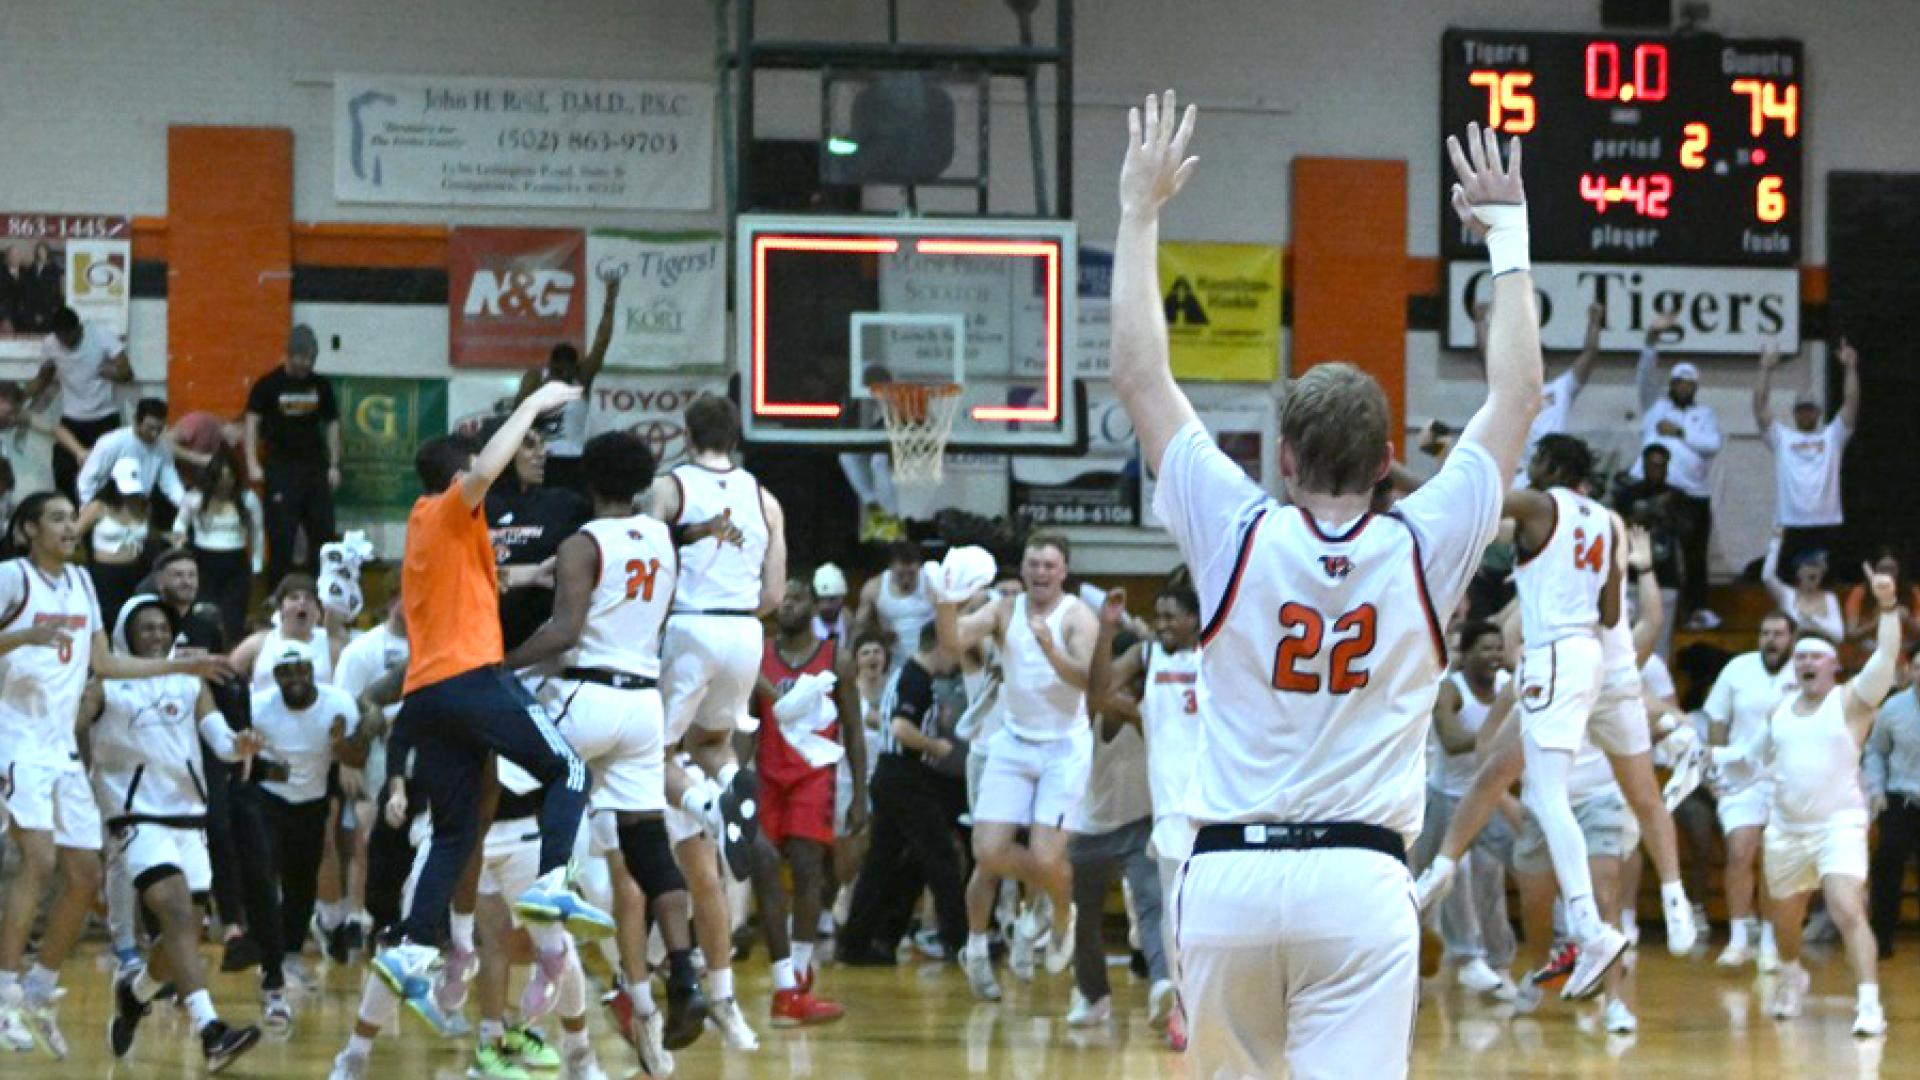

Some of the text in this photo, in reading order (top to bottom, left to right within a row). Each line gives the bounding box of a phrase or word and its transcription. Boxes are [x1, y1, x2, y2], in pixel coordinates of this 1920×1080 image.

[1585, 42, 1669, 102] 0.0
[1468, 69, 1536, 134] 75
[1731, 78, 1797, 139] 74
[498, 128, 560, 153] (502)
[1592, 137, 1662, 161] period
[1680, 122, 1710, 169] 2
[1580, 173, 1673, 219] 4-42
[1756, 175, 1787, 222] 6
[1590, 224, 1661, 251] player
[639, 245, 716, 289] Tigers!
[1577, 270, 1786, 346] Tigers
[1573, 526, 1604, 574] 24
[624, 556, 662, 603] 21
[1271, 601, 1379, 697] 22
